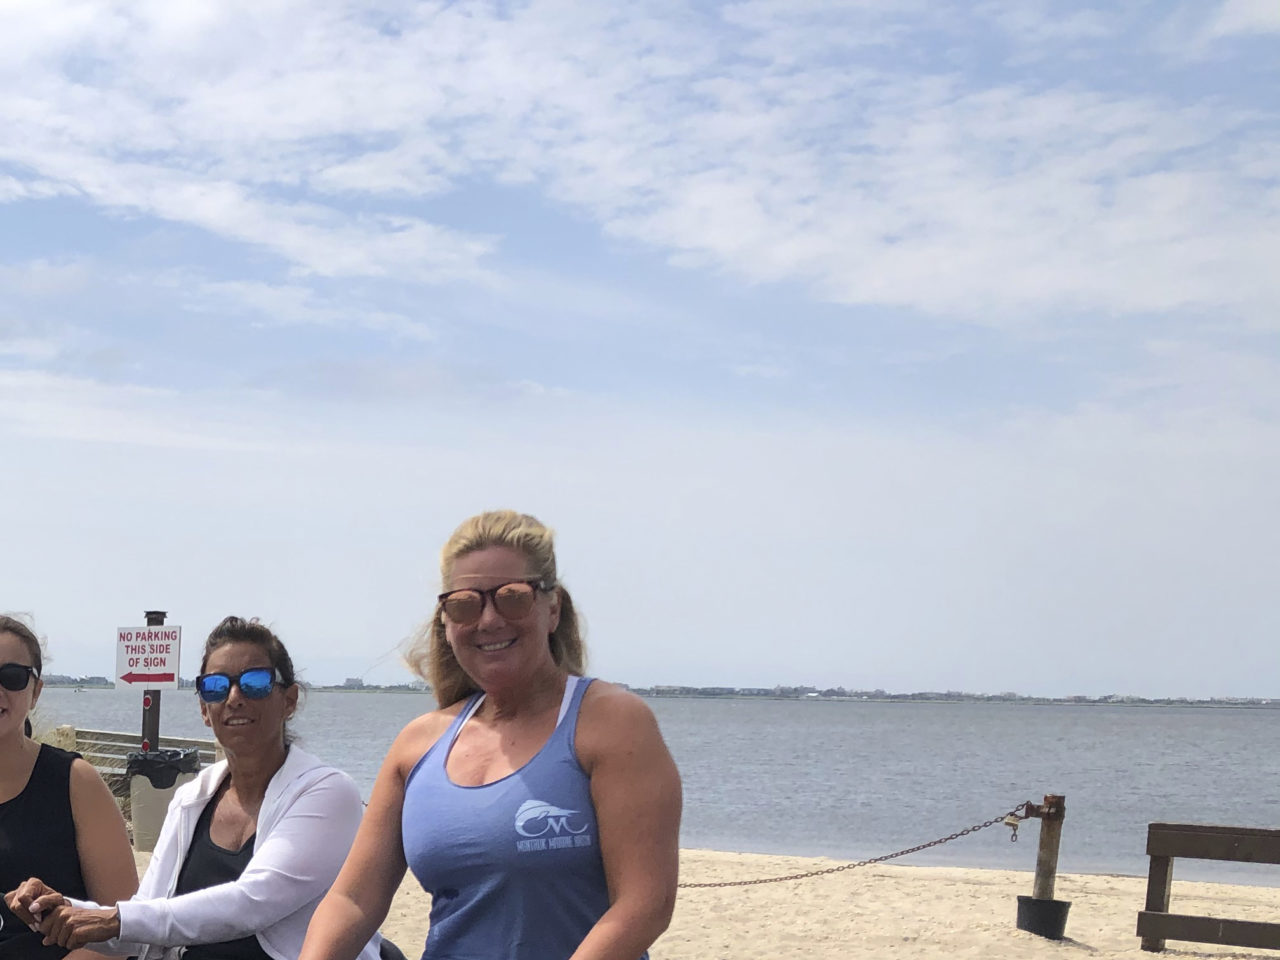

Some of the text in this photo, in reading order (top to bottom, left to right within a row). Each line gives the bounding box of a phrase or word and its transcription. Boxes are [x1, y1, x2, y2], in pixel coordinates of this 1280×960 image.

[120, 630, 177, 642] NO PARKING
[125, 643, 171, 655] THIS SIDE
[128, 657, 166, 667] OF SIGN
